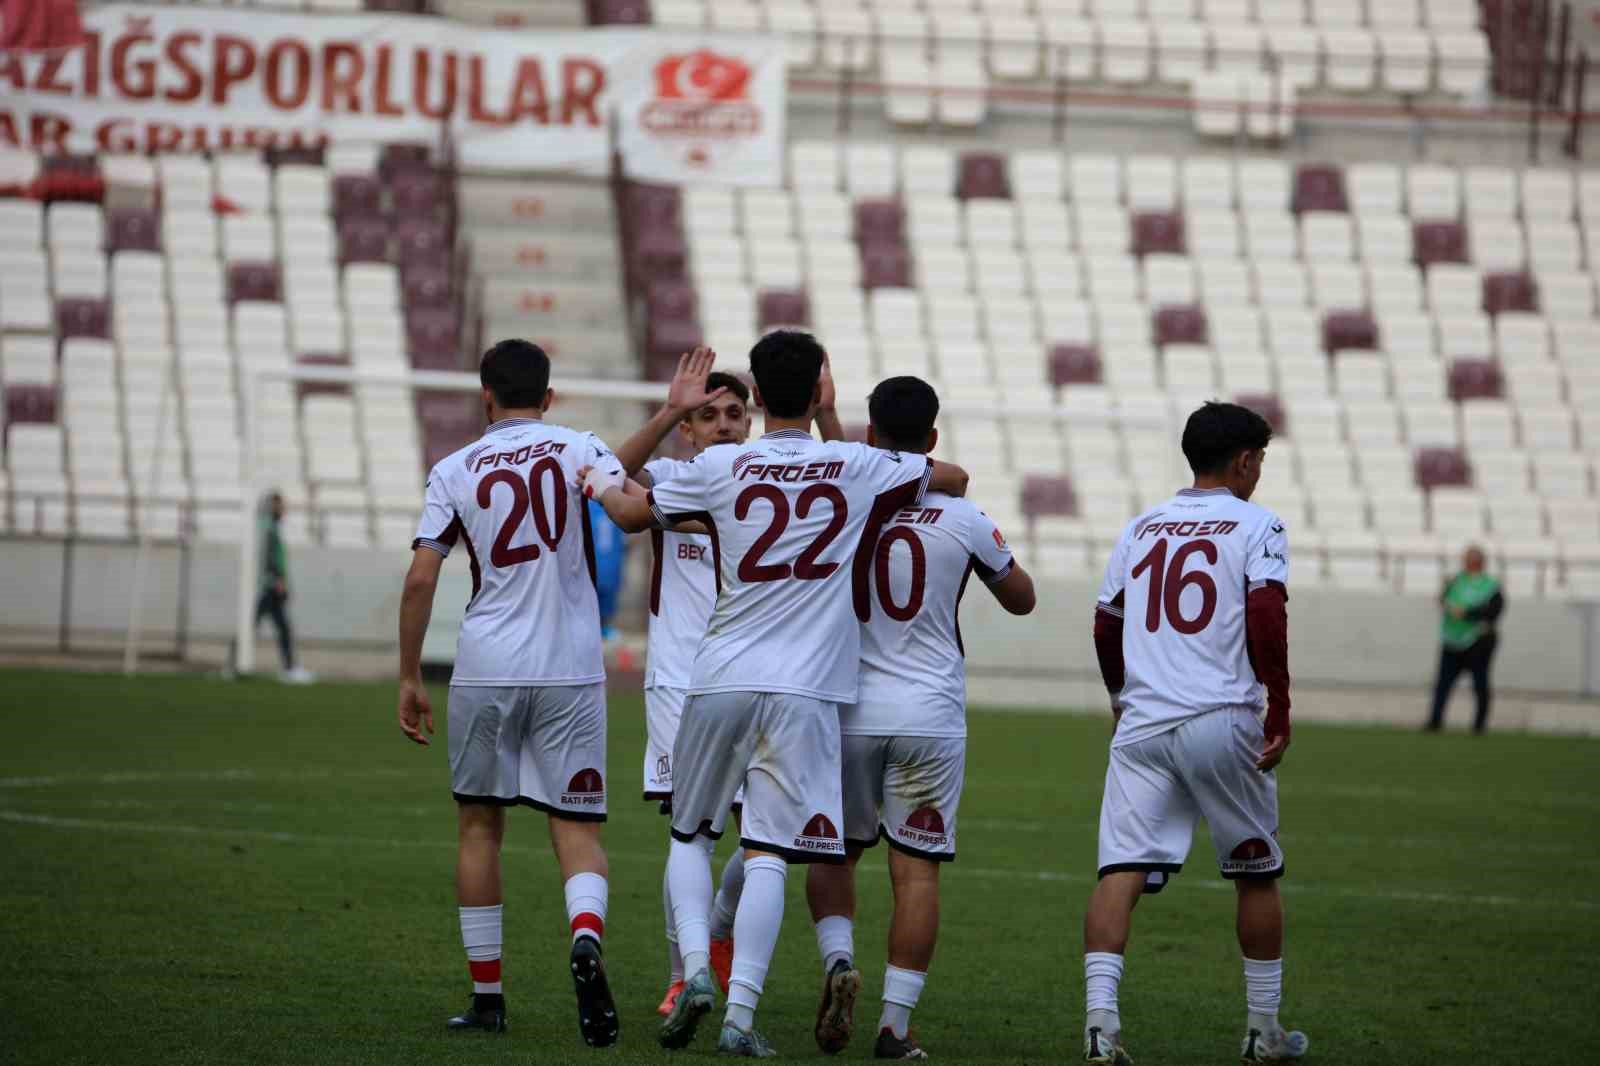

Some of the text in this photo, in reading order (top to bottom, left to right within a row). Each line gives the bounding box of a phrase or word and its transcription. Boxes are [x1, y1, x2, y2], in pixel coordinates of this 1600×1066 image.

[474, 439, 568, 473] PROEM
[738, 460, 846, 482] PROEM
[476, 456, 568, 569] 20
[734, 482, 849, 582] 22
[1138, 520, 1240, 540] PROEM
[677, 543, 707, 560] BEY
[1130, 537, 1218, 635] 16
